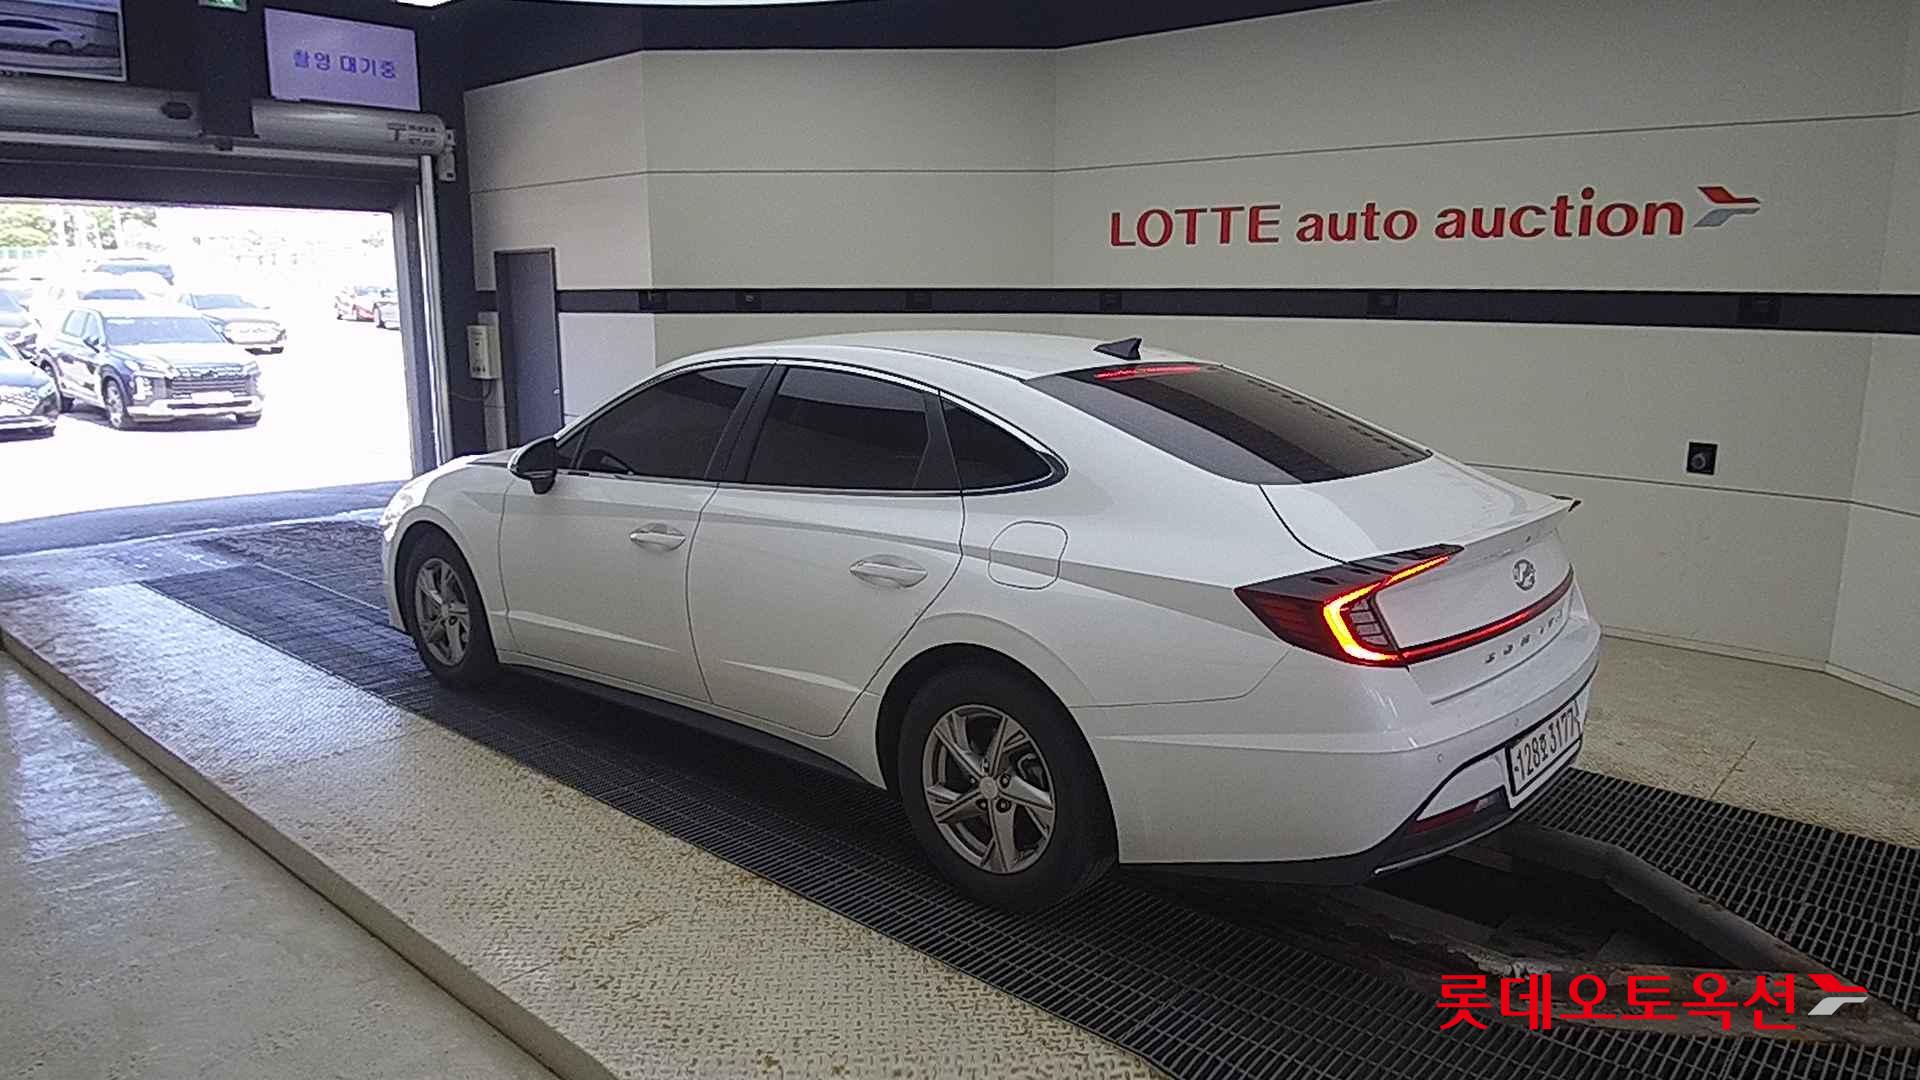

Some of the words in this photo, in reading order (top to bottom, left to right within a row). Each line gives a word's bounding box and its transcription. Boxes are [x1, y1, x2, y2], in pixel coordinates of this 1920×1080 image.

[340, 55, 397, 79] 대기중
[1110, 204, 1281, 247] LOTTE
[1296, 202, 1418, 243] auto
[1435, 186, 1685, 239] auction
